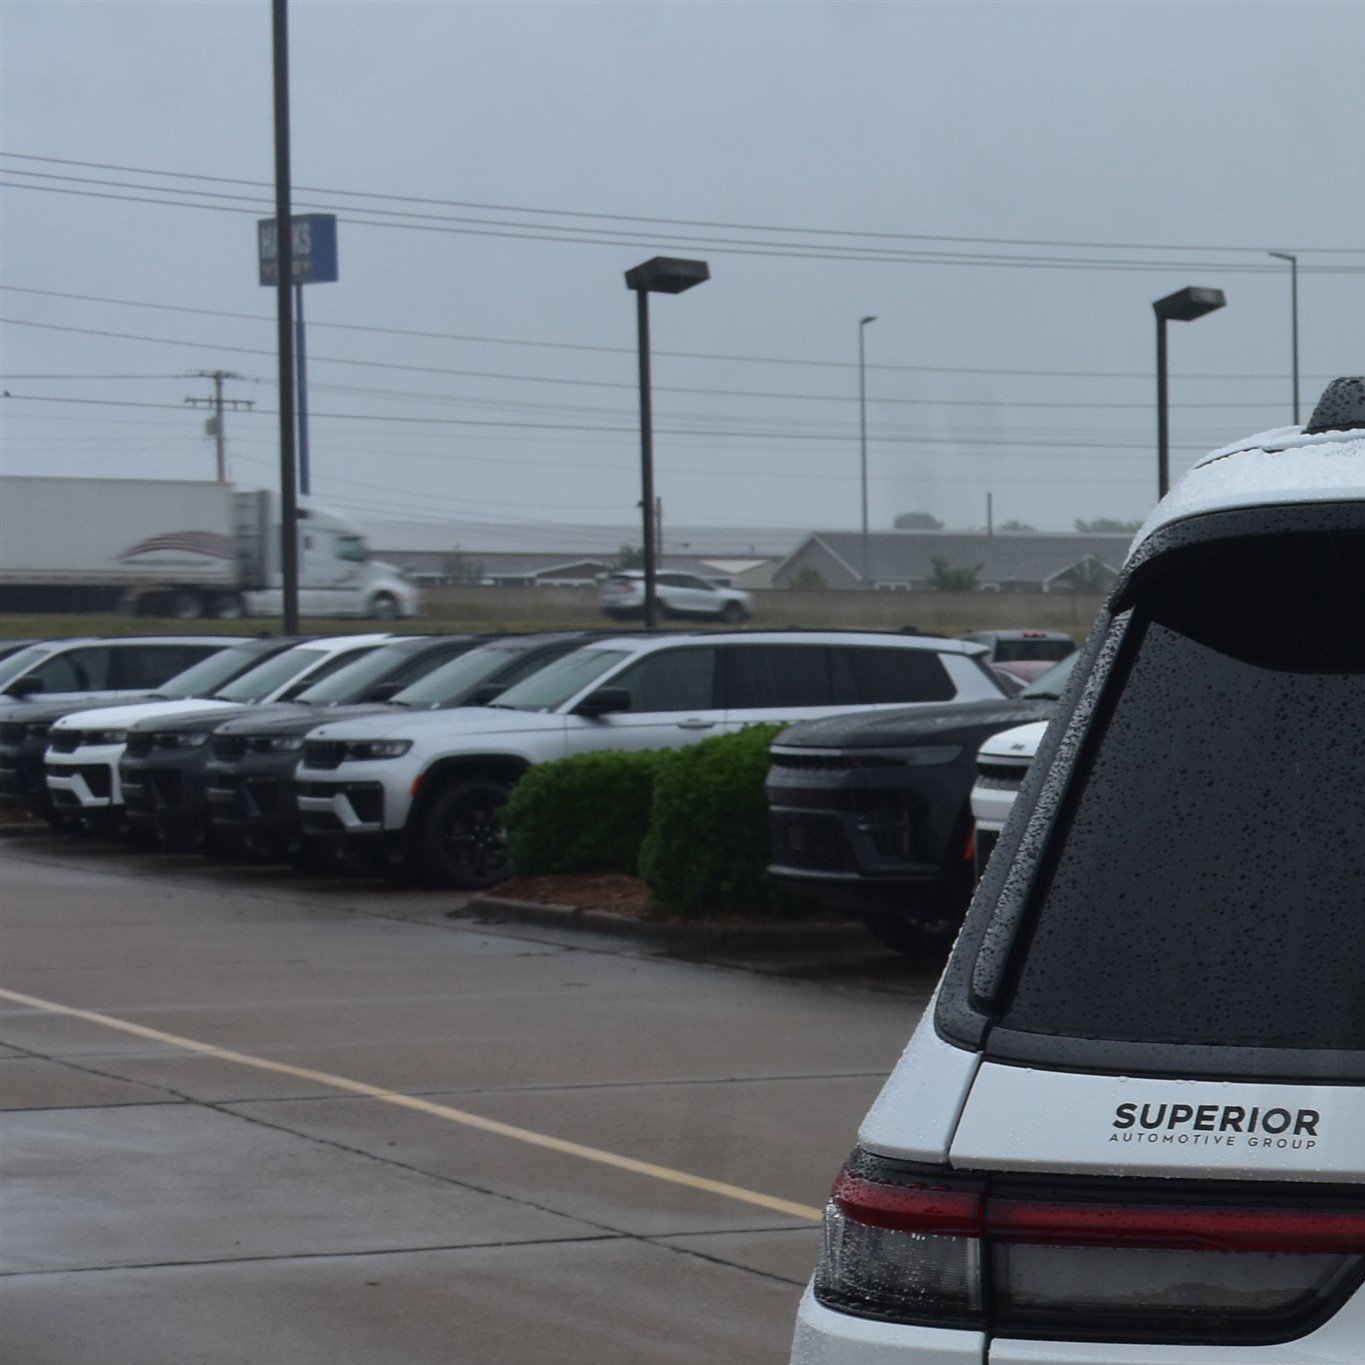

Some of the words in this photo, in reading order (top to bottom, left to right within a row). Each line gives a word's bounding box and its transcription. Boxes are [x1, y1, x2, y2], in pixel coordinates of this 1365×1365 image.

[1112, 1102, 1320, 1136] SUPERIOR
[1108, 1132, 1236, 1146] AUTOMOTIVE
[1248, 1137, 1317, 1150] GROUP
